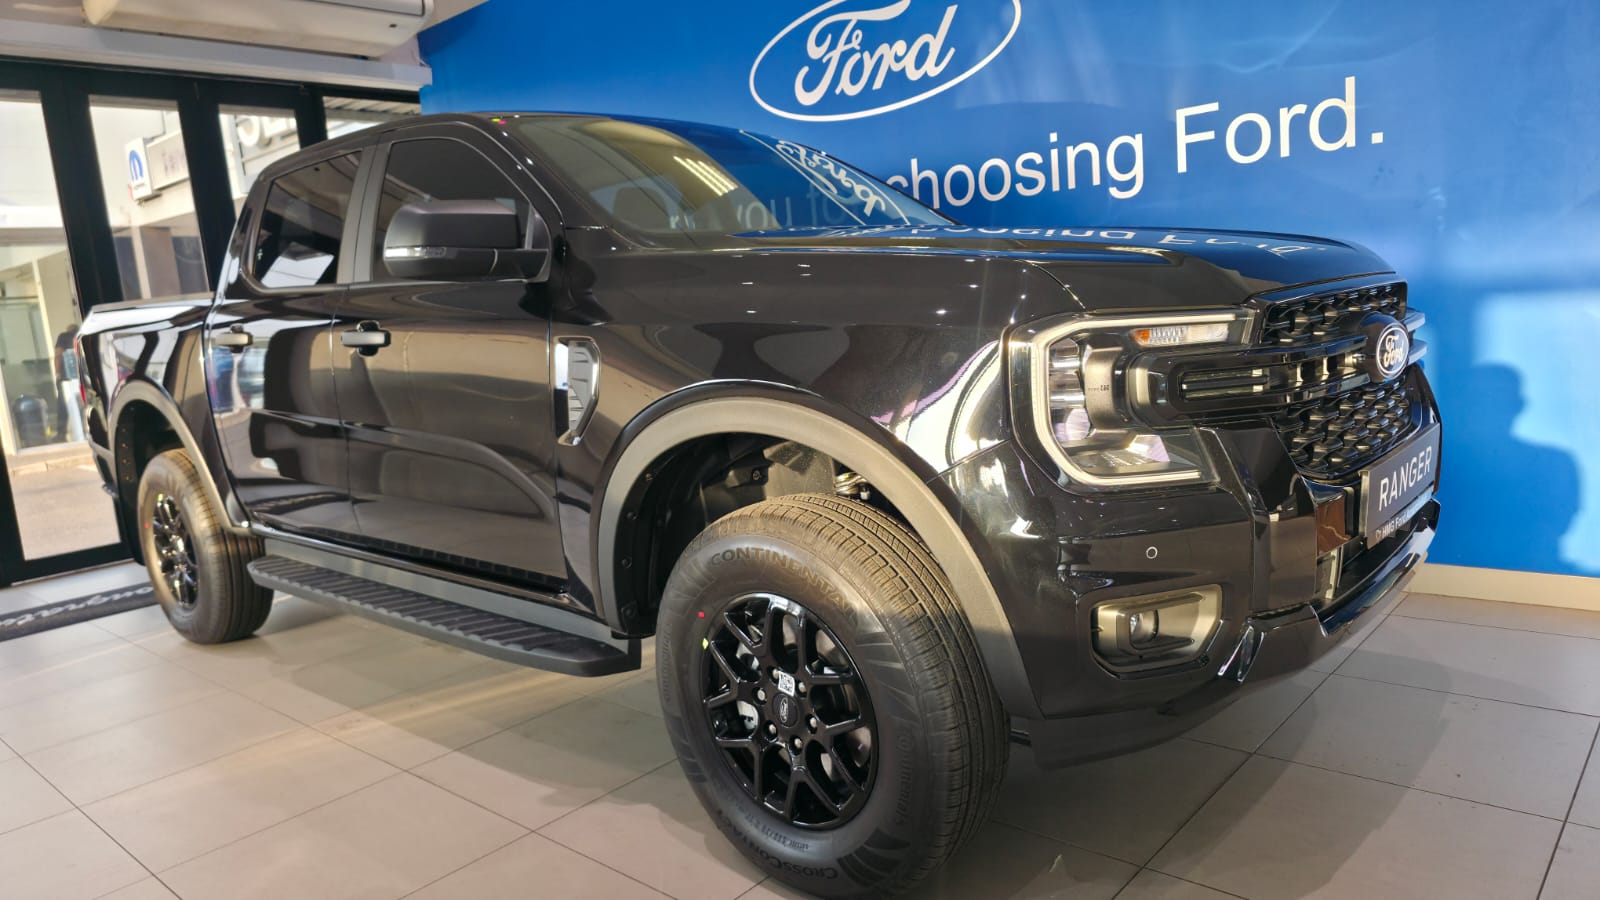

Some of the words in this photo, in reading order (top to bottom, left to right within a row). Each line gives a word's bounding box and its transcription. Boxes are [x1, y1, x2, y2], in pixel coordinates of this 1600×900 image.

[794, 0, 959, 106] Ford
[1176, 76, 1384, 174] Ford.
[1383, 334, 1405, 368] Ford
[1378, 446, 1432, 511] RANGER
